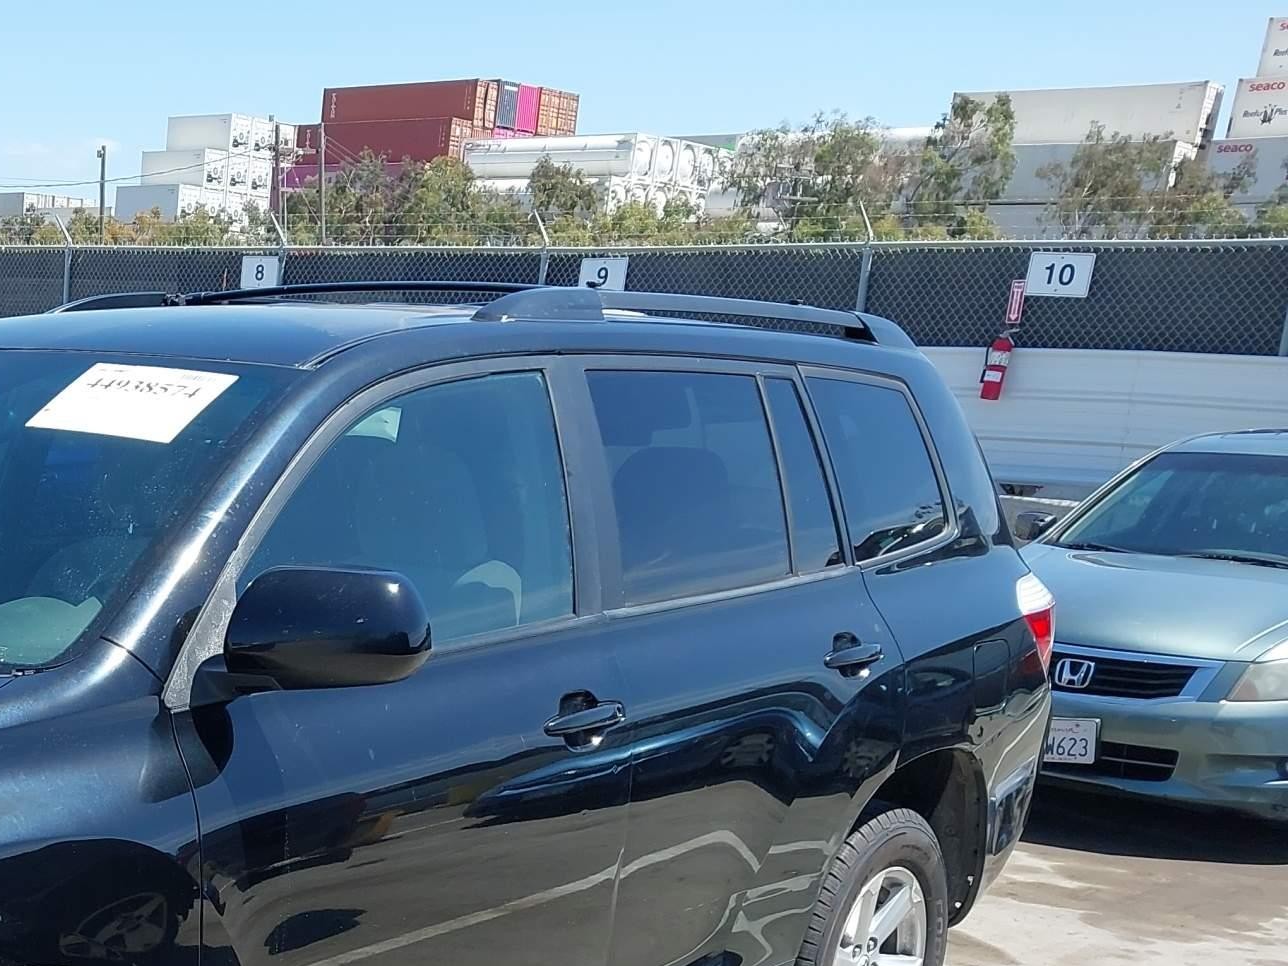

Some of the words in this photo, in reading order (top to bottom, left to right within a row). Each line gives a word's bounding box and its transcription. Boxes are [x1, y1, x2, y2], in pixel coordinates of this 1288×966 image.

[1248, 81, 1285, 92] seaco
[1217, 143, 1253, 154] seaco
[255, 264, 265, 282] 8
[596, 266, 609, 287] 9
[1045, 263, 1076, 286] 10
[87, 377, 202, 399] 44938574
